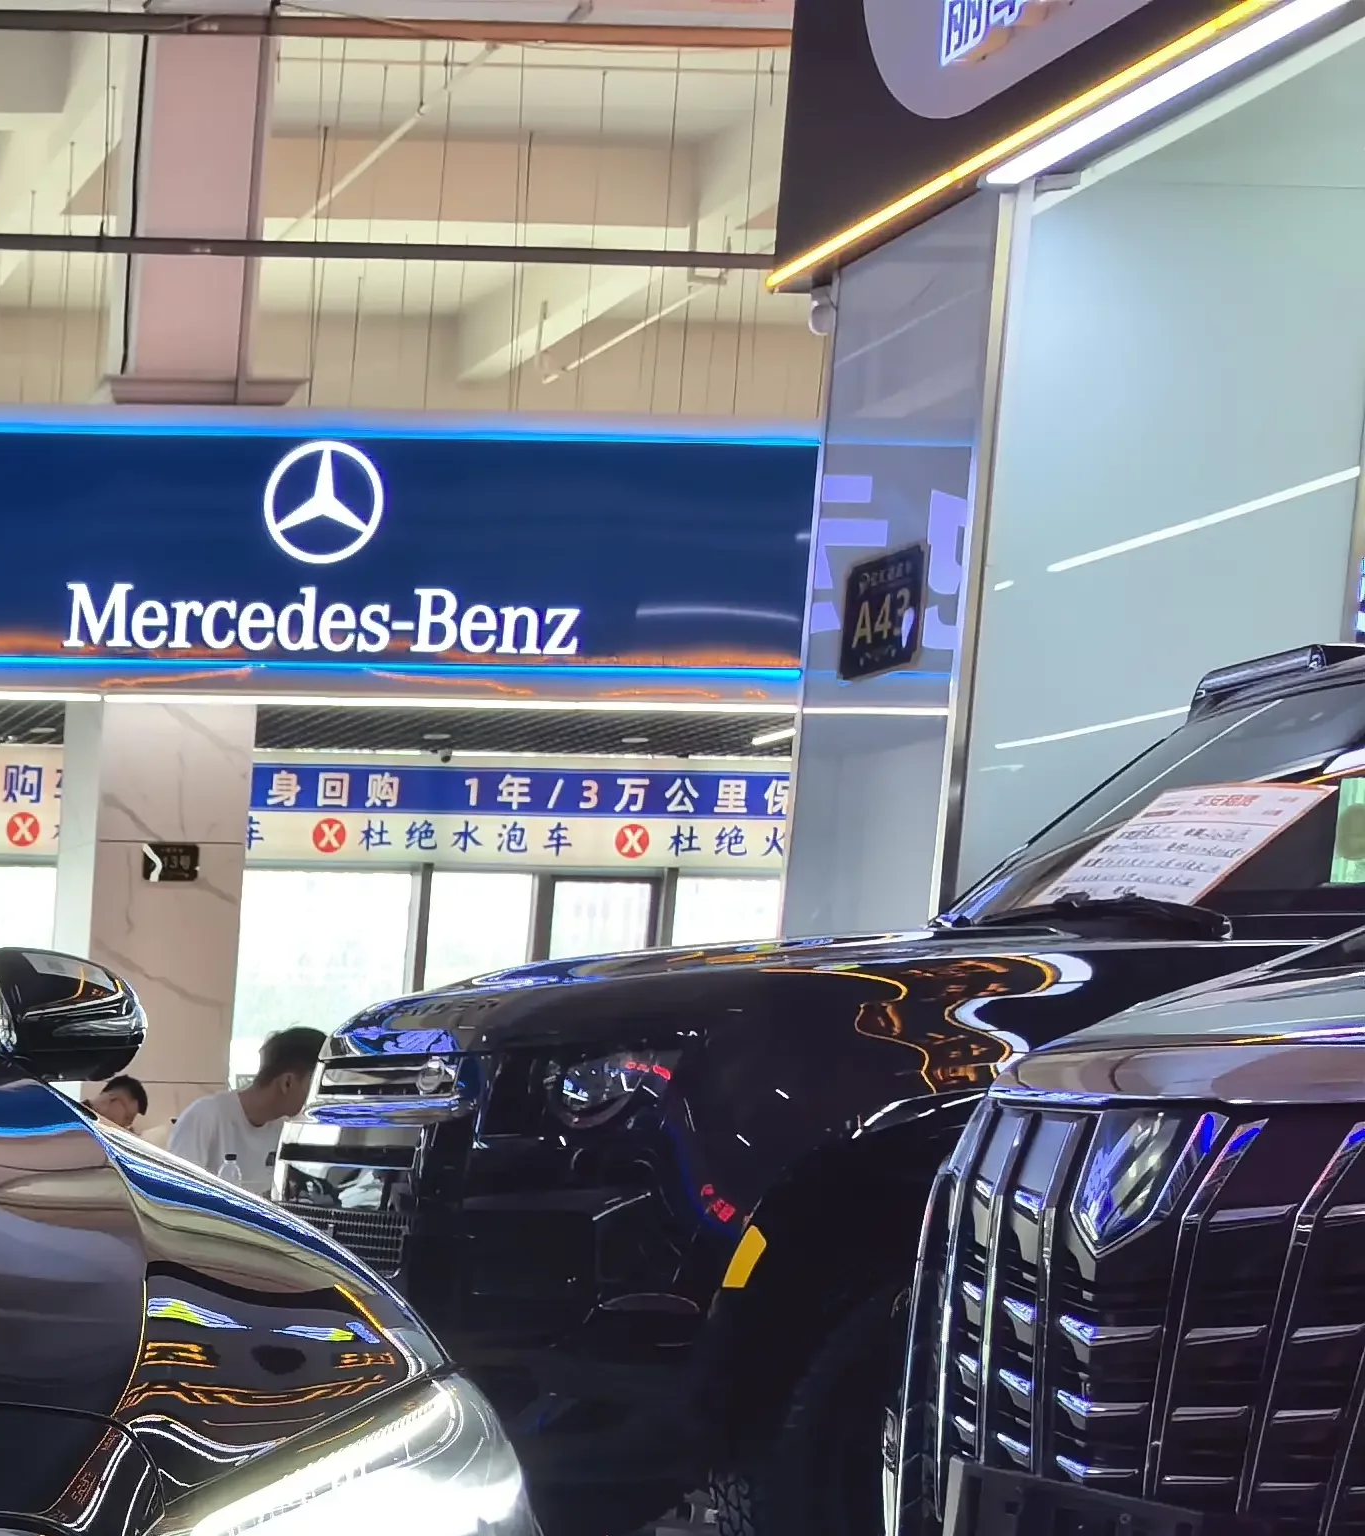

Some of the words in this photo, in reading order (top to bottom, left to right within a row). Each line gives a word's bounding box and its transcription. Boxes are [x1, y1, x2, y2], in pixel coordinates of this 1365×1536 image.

[64, 581, 581, 656] Mercedes-Benz
[3, 763, 62, 804] 购
[358, 819, 573, 858] 杜绝水泡车
